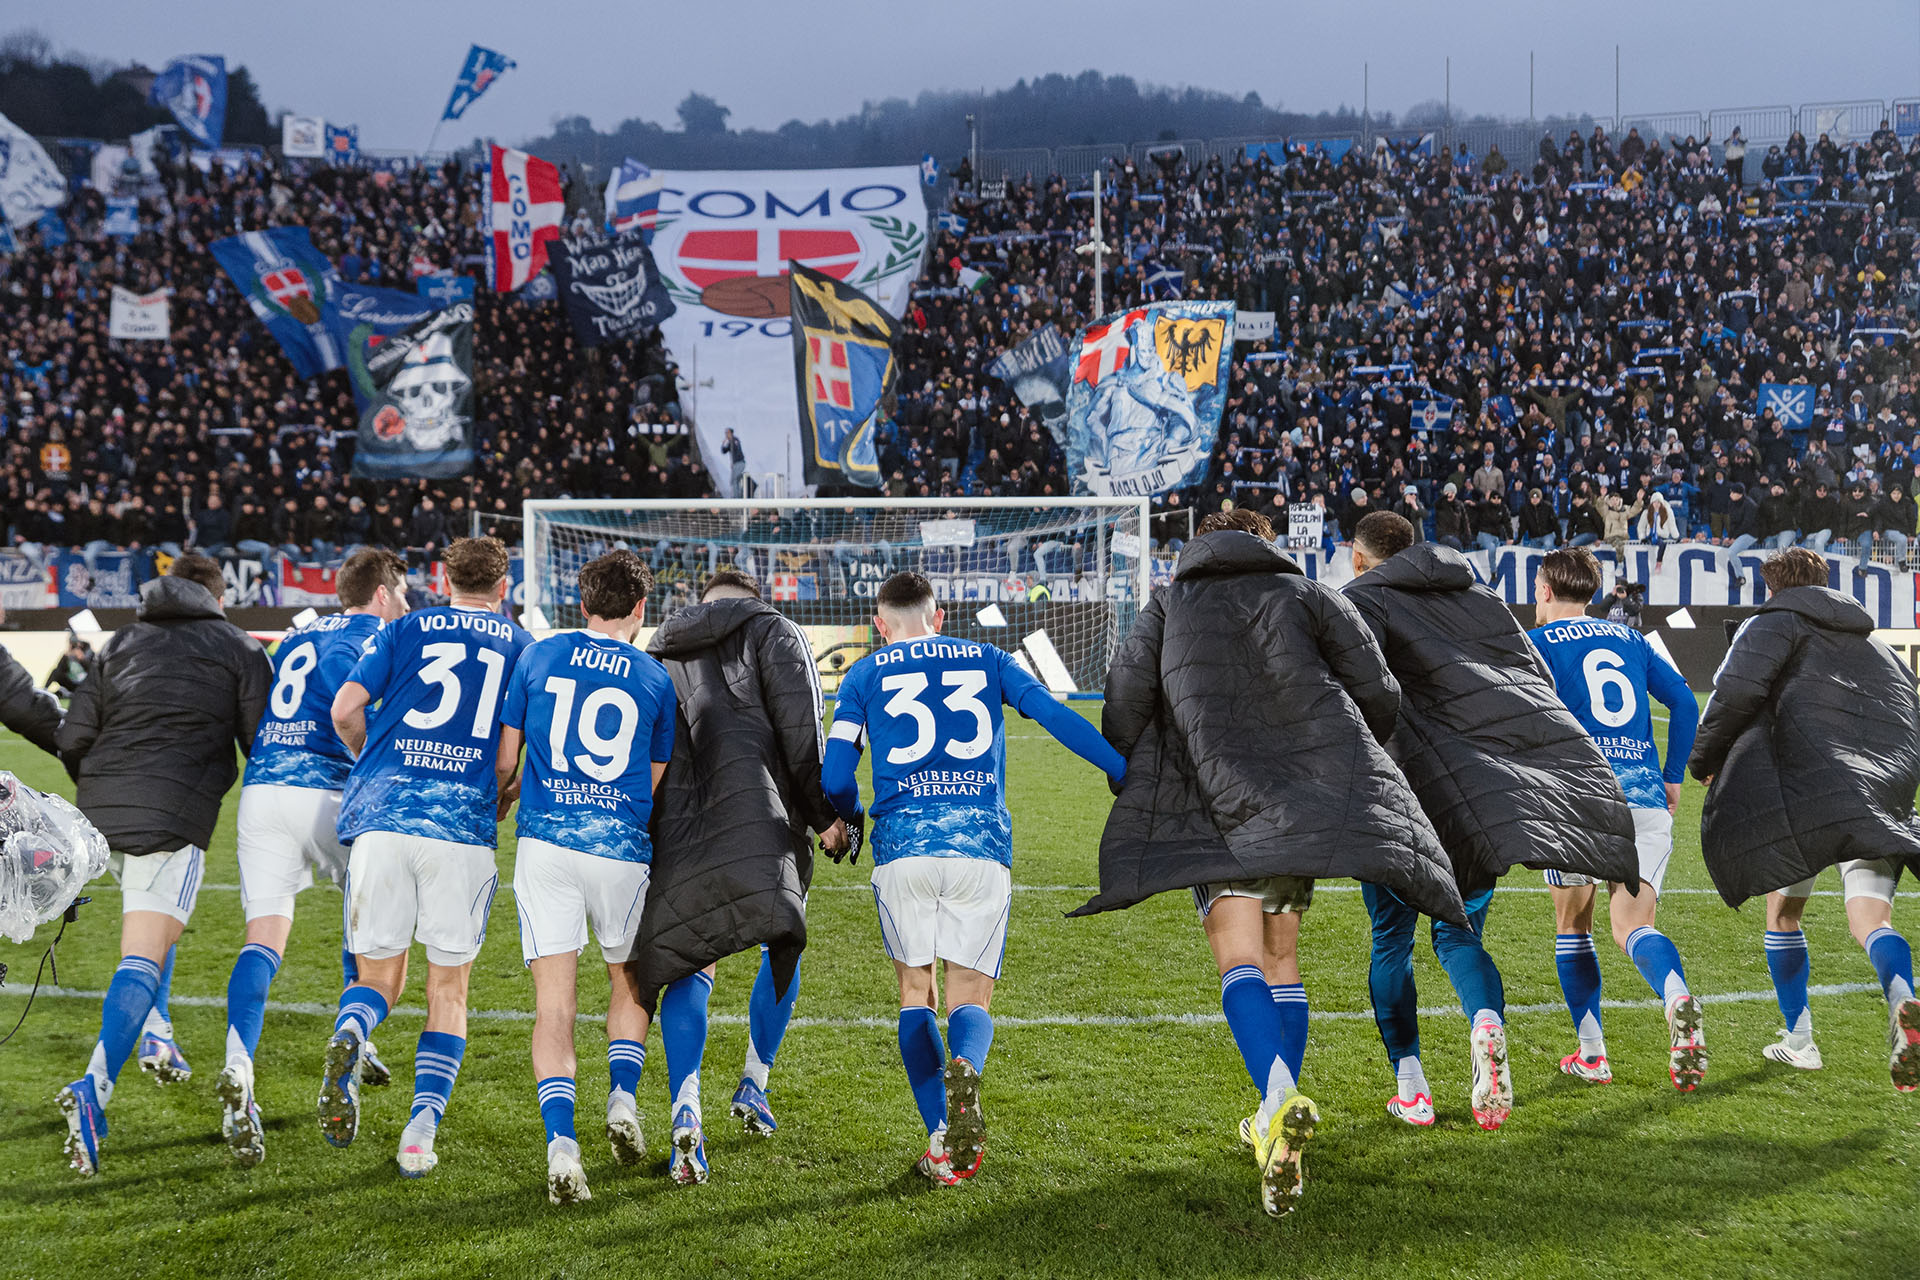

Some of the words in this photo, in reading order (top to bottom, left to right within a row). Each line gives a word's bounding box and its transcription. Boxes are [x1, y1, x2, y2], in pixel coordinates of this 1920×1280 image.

[509, 174, 531, 260] COMO
[699, 320, 793, 337] 190
[1296, 526, 1308, 535] LA
[419, 615, 513, 642] VOJVODA
[875, 649, 904, 666] DA
[910, 643, 982, 659] CUNHA
[271, 641, 317, 719] 8
[402, 642, 505, 739] 31
[1583, 648, 1636, 728] 6
[881, 670, 993, 764] 33
[544, 676, 639, 783] 19
[394, 738, 483, 761] NEUBERGER
[403, 755, 466, 773] BERMAN
[897, 770, 995, 792] NEUBERGER
[913, 784, 981, 798] BERMAN
[555, 792, 617, 812] BERMAN
